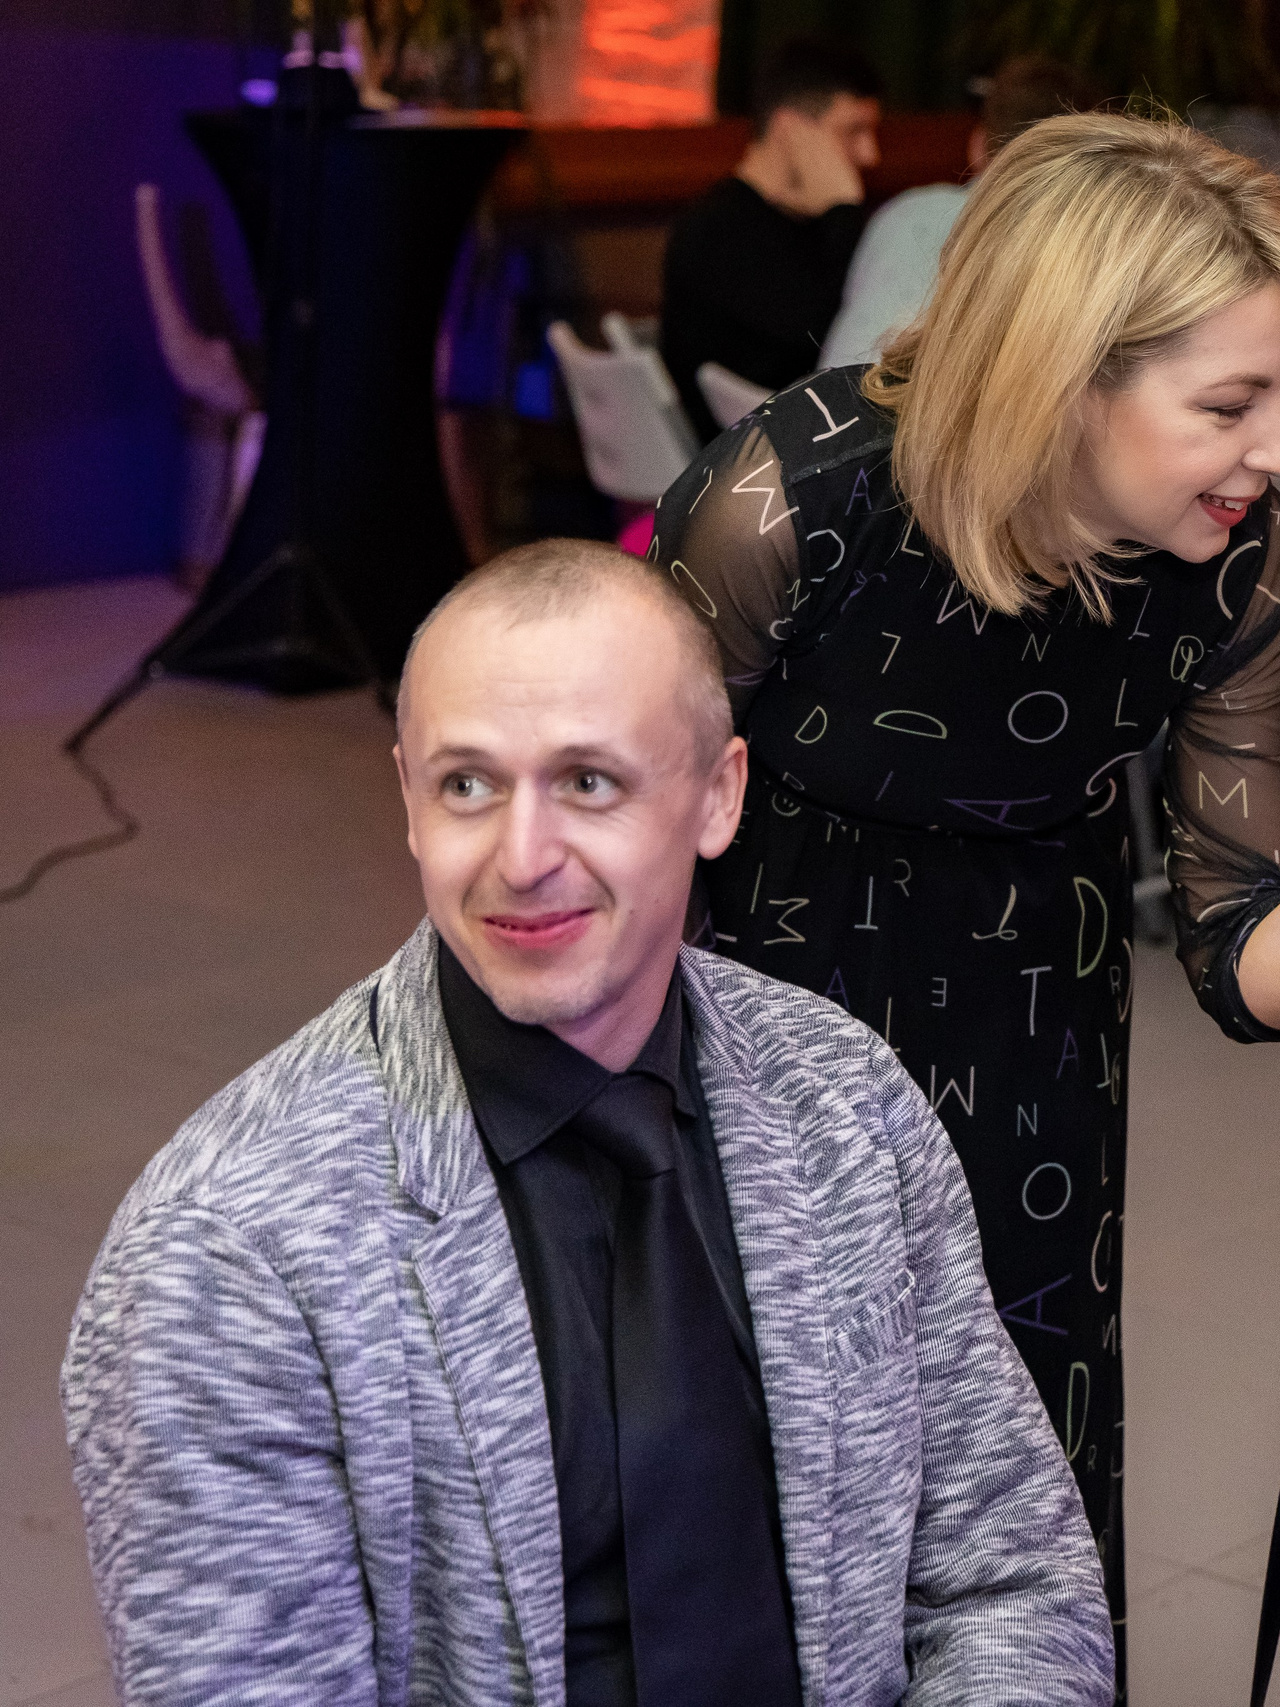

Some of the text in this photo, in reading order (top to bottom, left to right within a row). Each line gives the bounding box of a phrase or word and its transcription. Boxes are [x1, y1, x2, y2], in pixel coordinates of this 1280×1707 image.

[845, 467, 873, 516] A
[1007, 690, 1069, 744] O
[1115, 677, 1139, 728] L
[1199, 770, 1249, 819] M
[1020, 965, 1053, 1037] T
[1056, 1028, 1079, 1080] A
[1016, 1102, 1039, 1137] N
[1022, 1162, 1072, 1221] O
